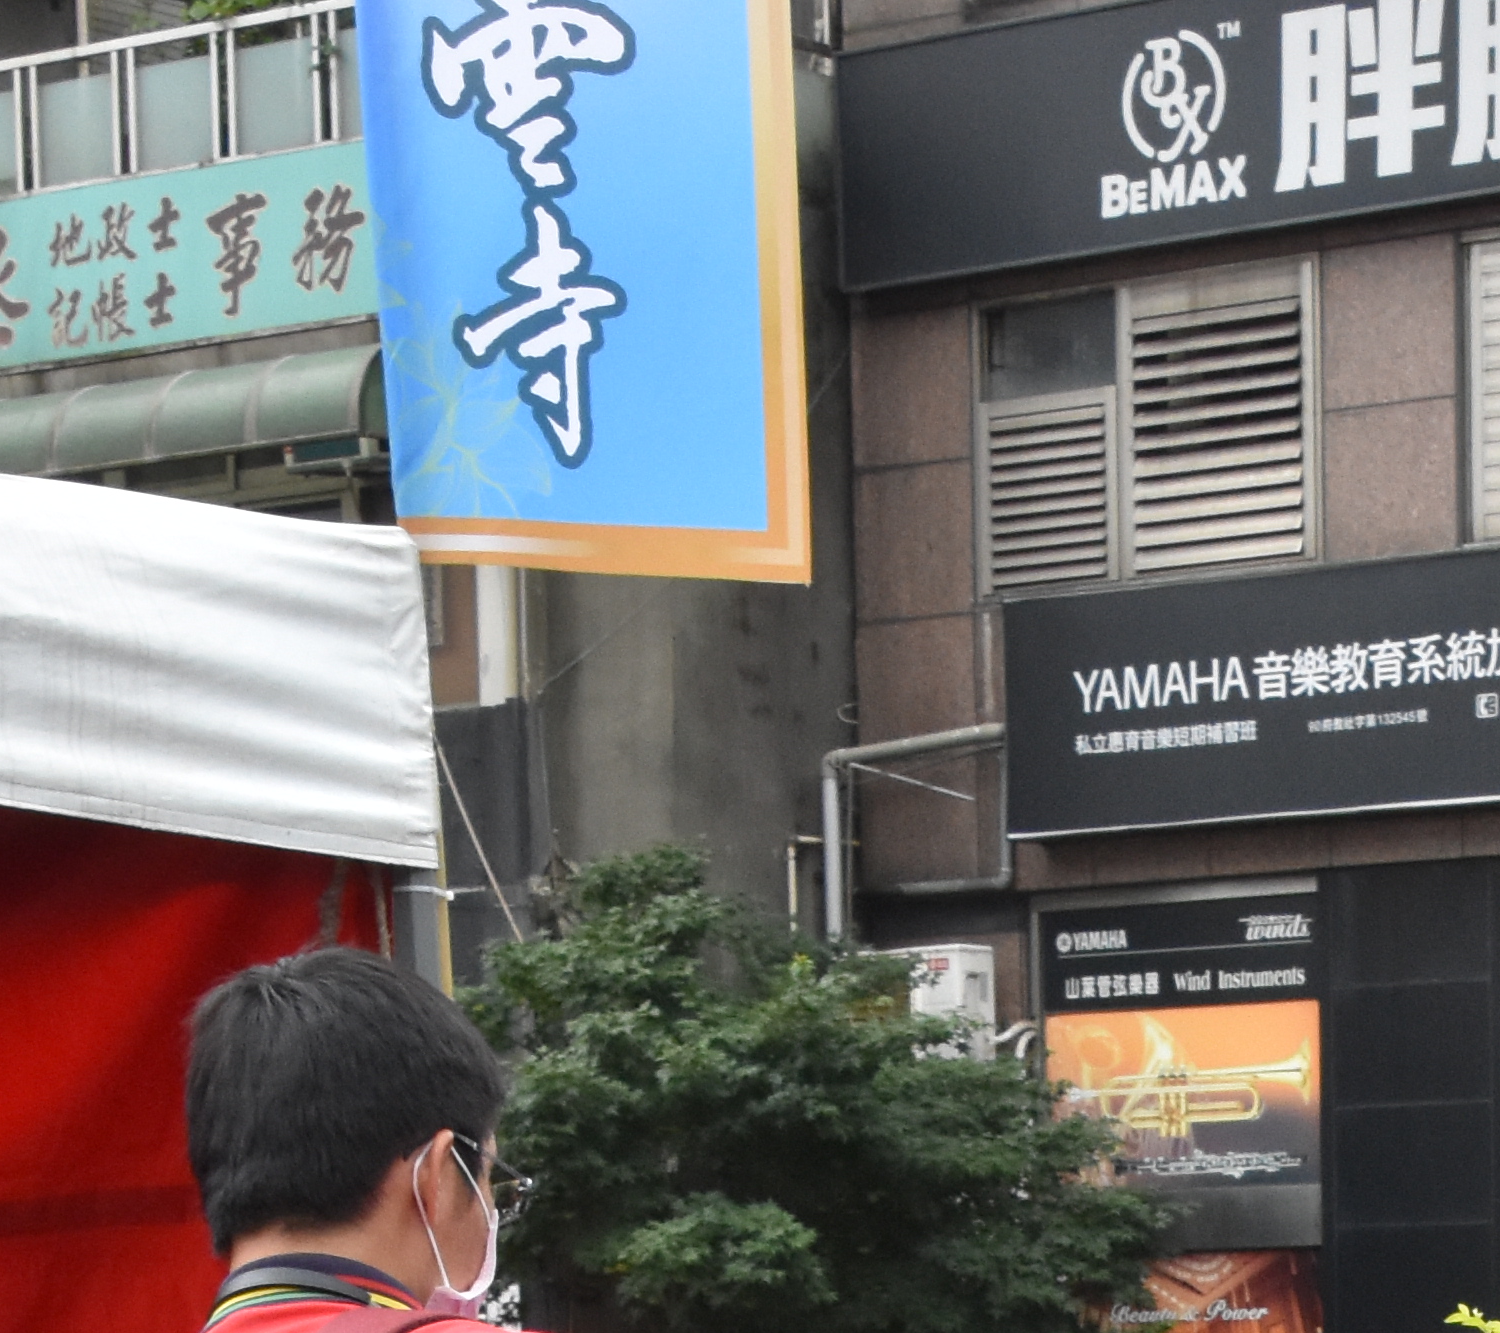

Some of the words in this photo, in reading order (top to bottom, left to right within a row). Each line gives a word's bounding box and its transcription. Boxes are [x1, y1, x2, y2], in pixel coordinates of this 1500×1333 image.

[48, 197, 181, 268] 地政士
[205, 184, 366, 317] 事務
[47, 273, 178, 348] 記帳士
[1073, 656, 1250, 714] YAMAHA
[1072, 929, 1129, 951] YAMAHA
[1172, 968, 1212, 992] Wind
[1217, 966, 1307, 990] Instruments
[1203, 1299, 1269, 1322] Power
